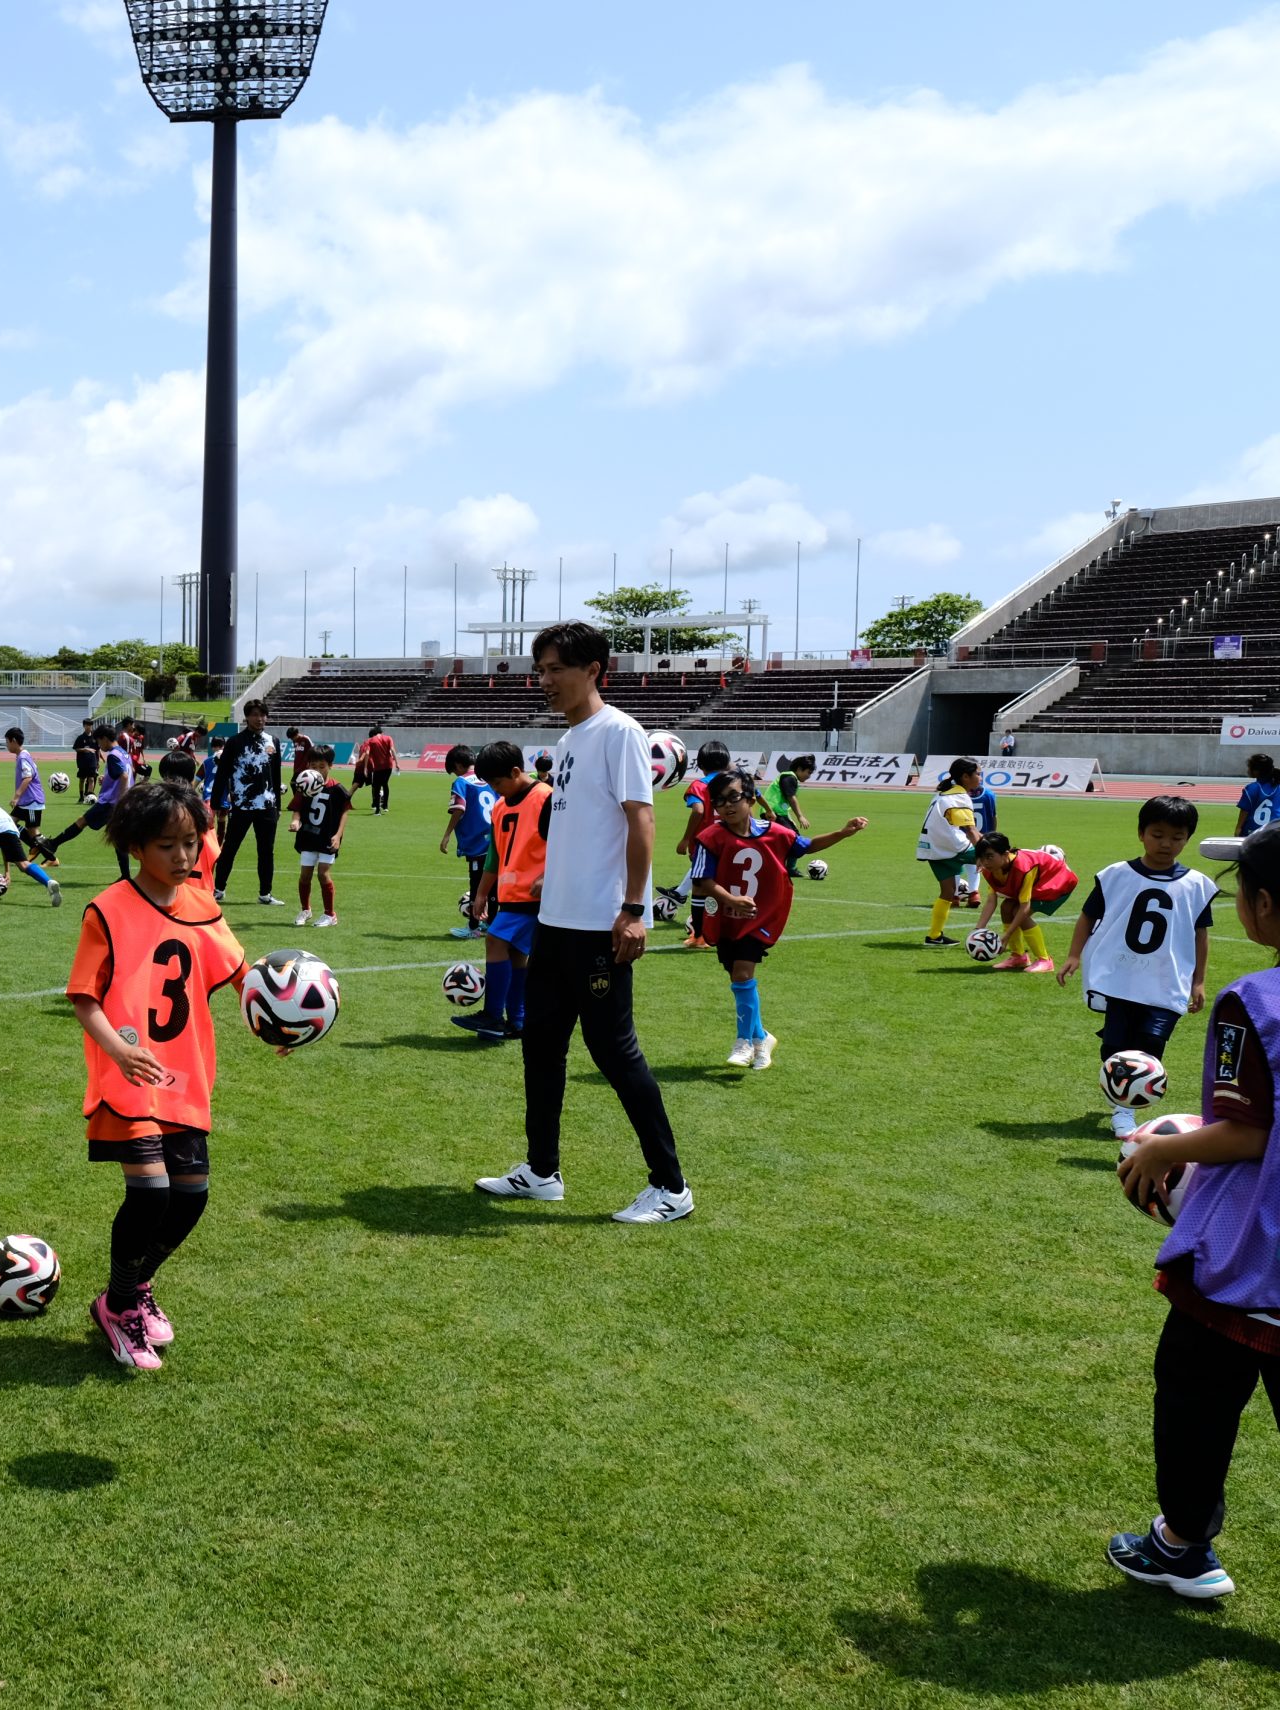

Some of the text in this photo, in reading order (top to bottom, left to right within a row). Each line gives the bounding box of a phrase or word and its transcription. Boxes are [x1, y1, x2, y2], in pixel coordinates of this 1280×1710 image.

[815, 769, 897, 783] カヤック
[822, 754, 901, 768] 面白法人
[309, 792, 330, 826] 5
[478, 790, 496, 825] 8
[1253, 799, 1273, 826] 6
[501, 812, 520, 867] 7
[730, 847, 763, 899] 3
[1125, 888, 1174, 954] 6
[148, 938, 193, 1043] 3
